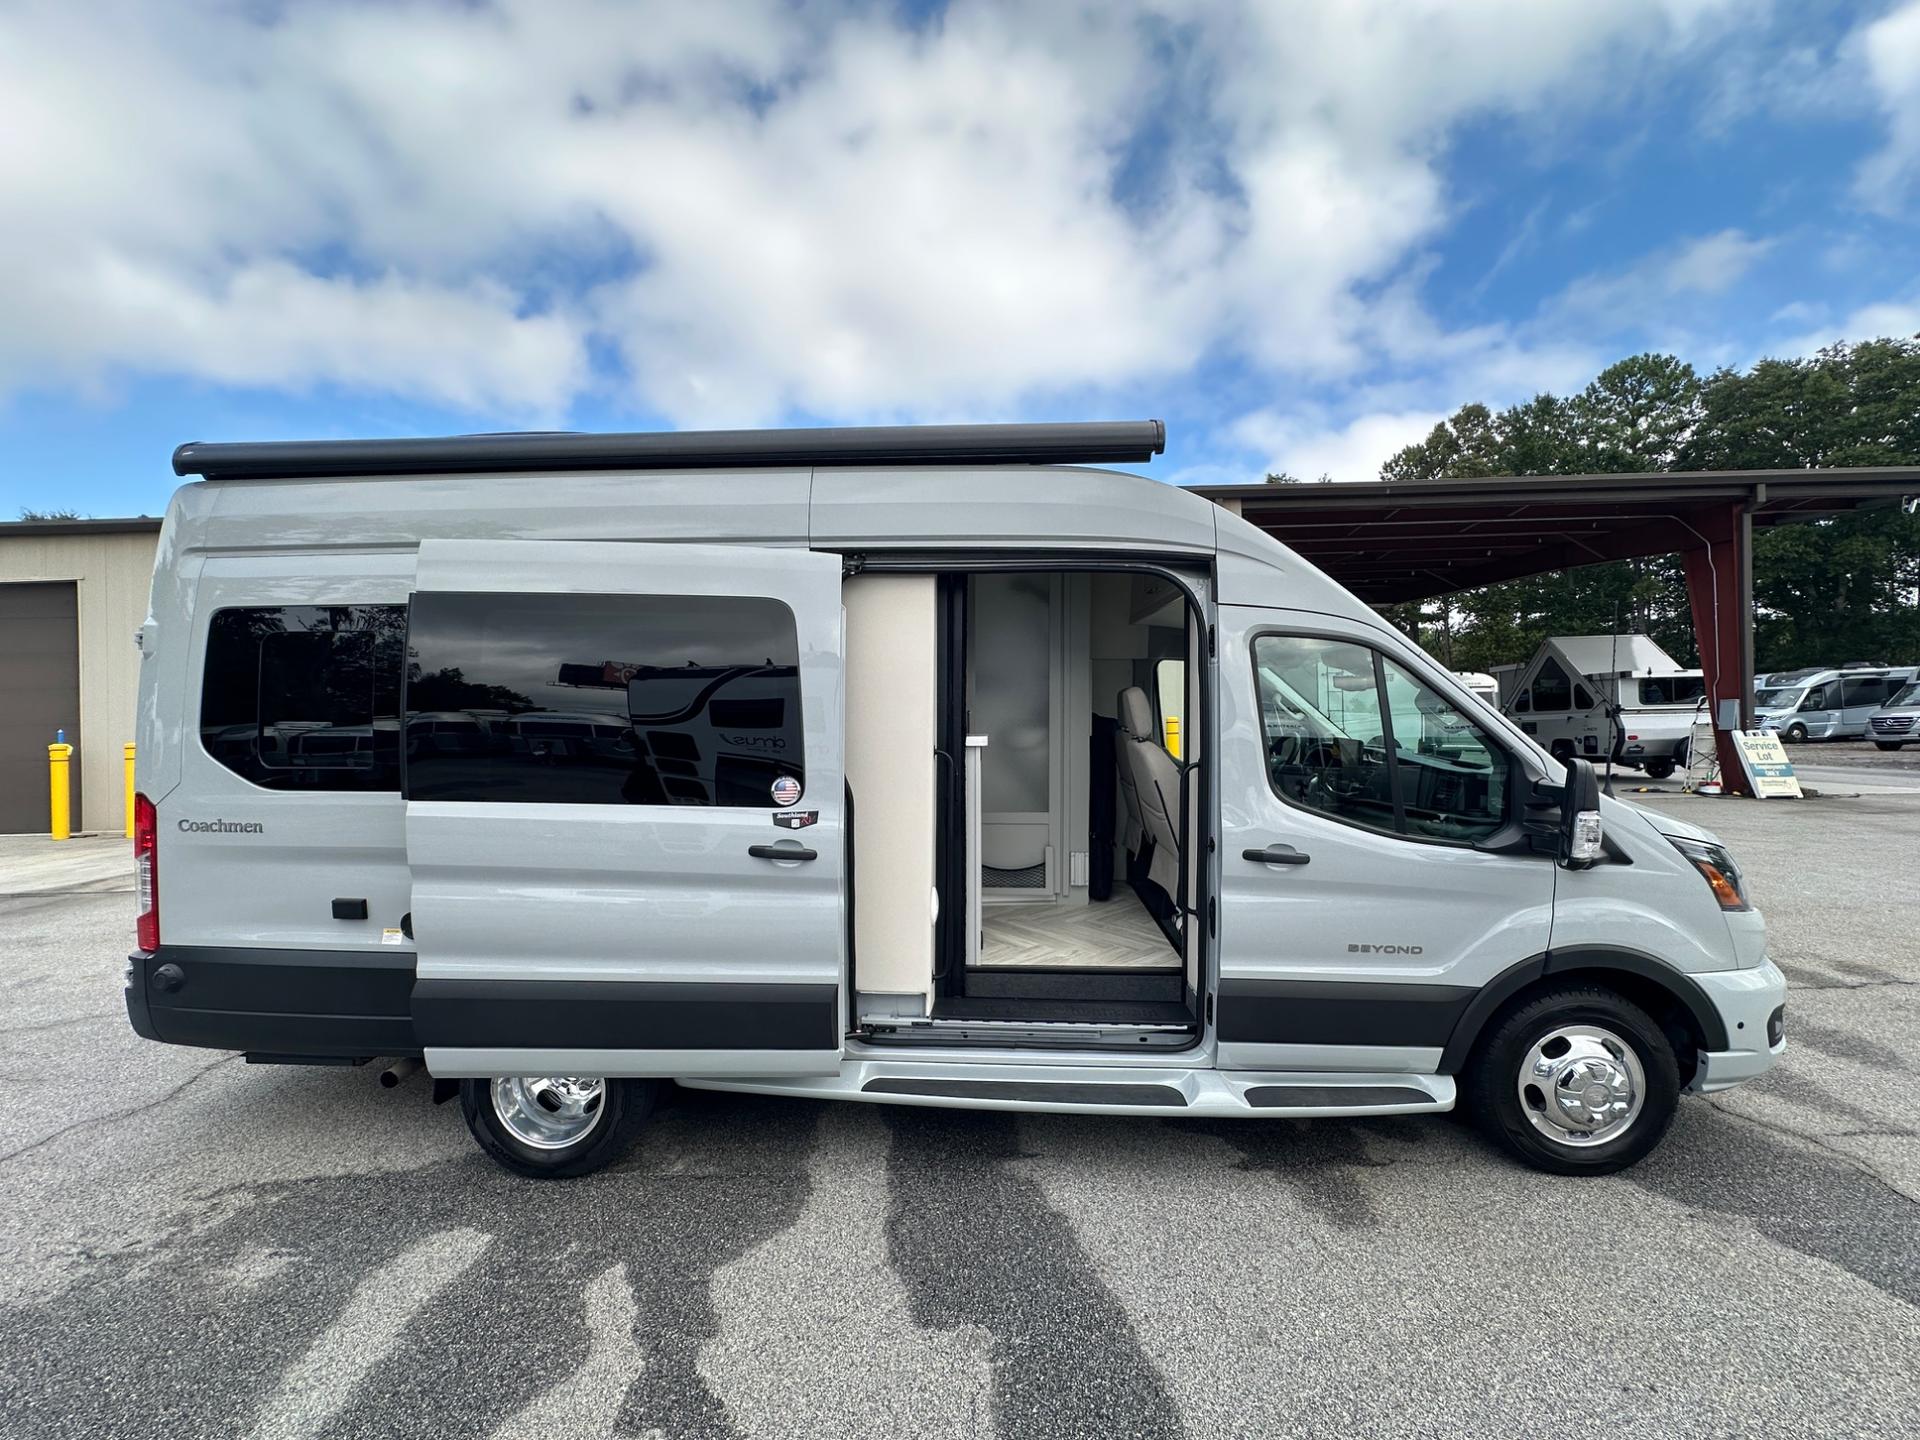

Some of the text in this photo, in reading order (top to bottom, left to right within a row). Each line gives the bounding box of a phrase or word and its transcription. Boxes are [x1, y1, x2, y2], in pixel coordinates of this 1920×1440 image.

[1743, 741, 1779, 750] Service
[1756, 751, 1774, 761] Lot
[177, 818, 264, 834] Coachmen
[1347, 943, 1424, 955] BEYOND
